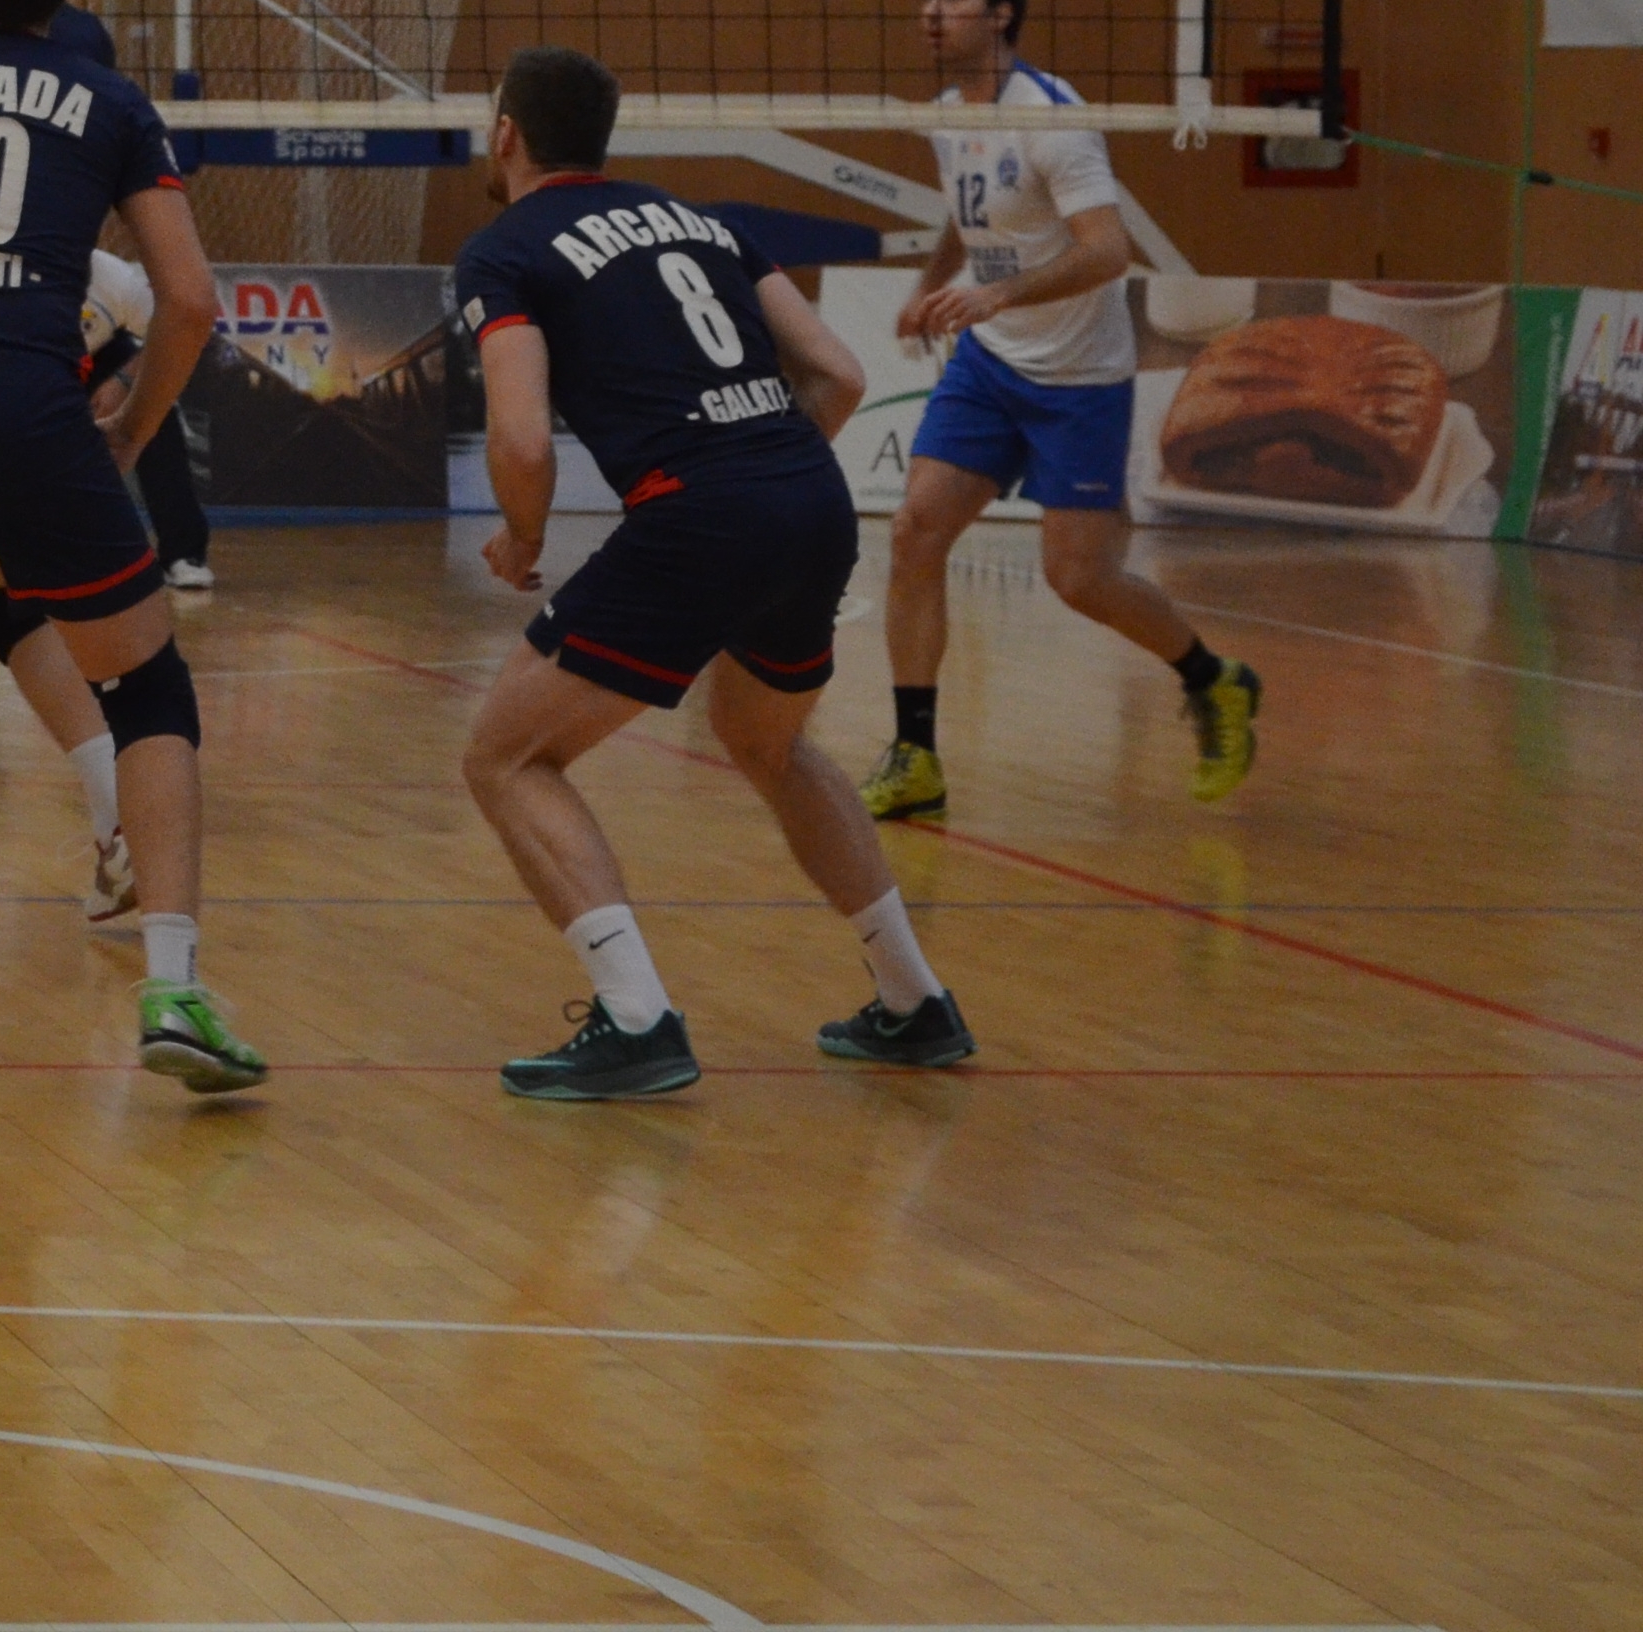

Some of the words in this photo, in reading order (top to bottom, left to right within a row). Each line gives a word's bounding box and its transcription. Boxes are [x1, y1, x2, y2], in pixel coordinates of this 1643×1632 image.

[550, 200, 742, 282] ARCADA
[958, 173, 989, 228] 12
[657, 251, 745, 369] 8
